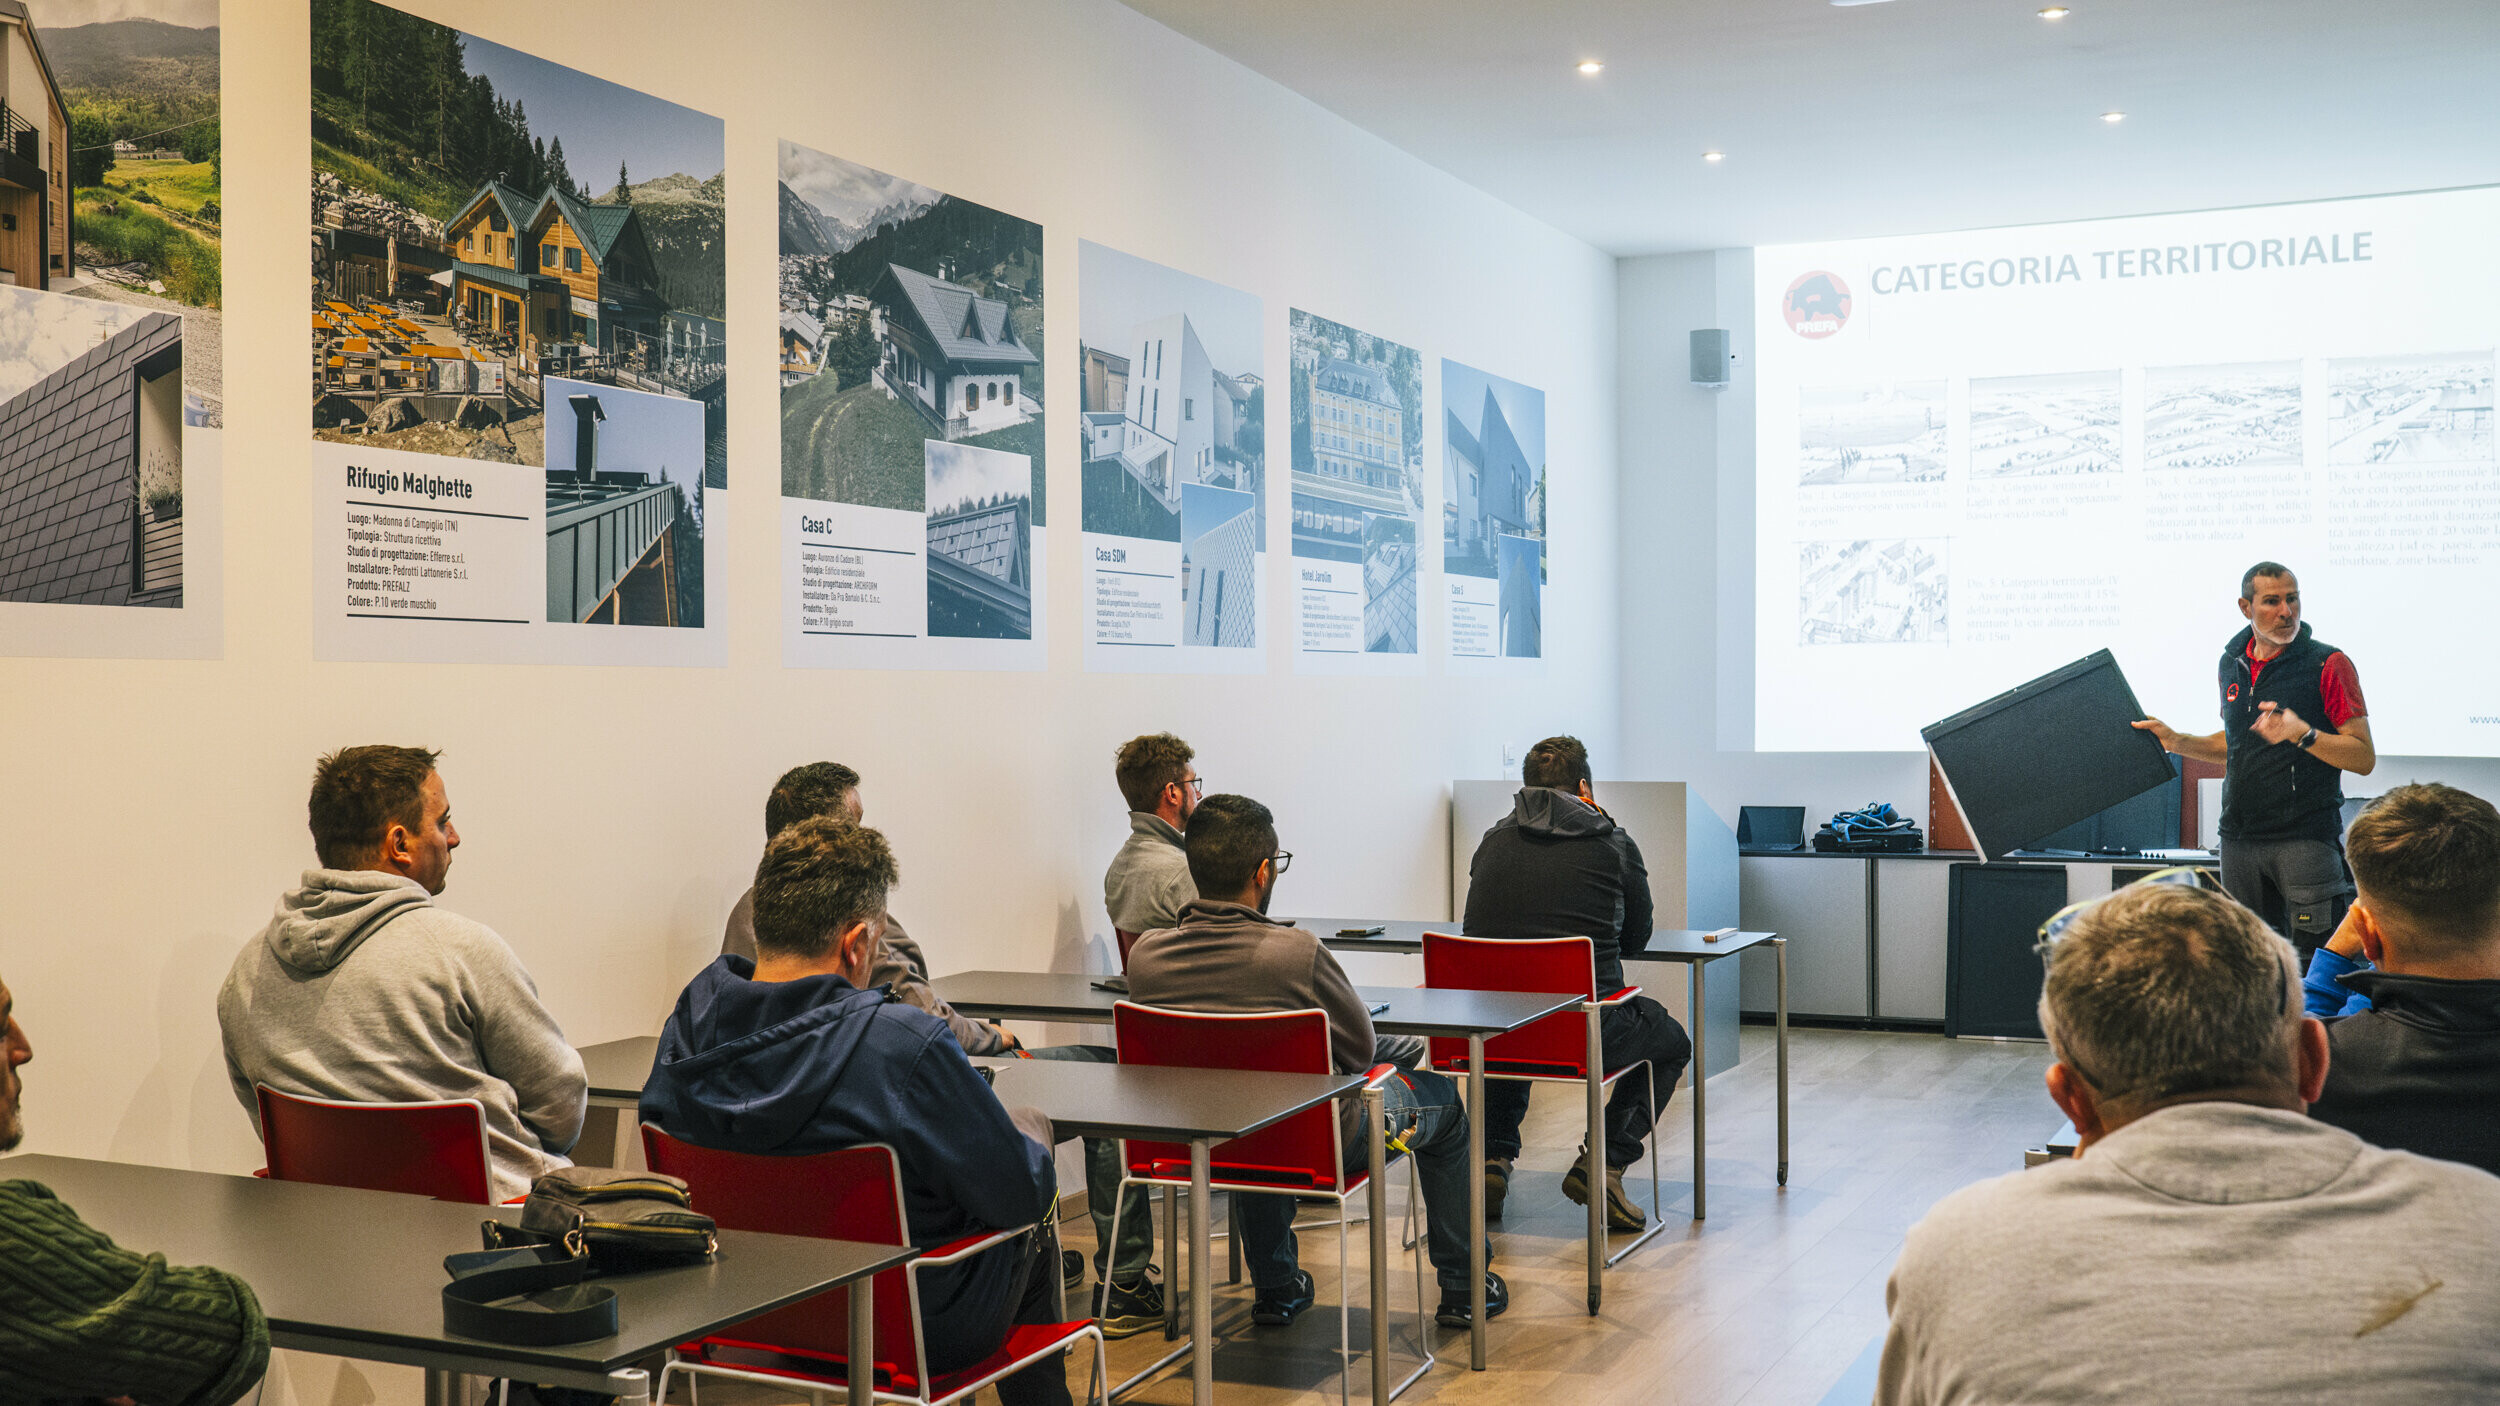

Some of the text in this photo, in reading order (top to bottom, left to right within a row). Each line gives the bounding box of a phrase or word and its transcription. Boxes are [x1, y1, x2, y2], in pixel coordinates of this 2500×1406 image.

[1871, 231, 2373, 295] CATEGORIA TERRITORIALE
[1796, 319, 1838, 334] PREFA
[2368, 470, 2422, 481] Categoria
[2426, 466, 2487, 478] territoriale
[347, 465, 473, 500] Rifugio Malghette
[2339, 485, 2365, 495] Aree
[2368, 485, 2389, 494] con
[2392, 484, 2460, 496] vegetazione
[2464, 481, 2479, 491] ed
[2363, 498, 2403, 509] altezza
[2406, 497, 2460, 508] uniforme
[347, 512, 371, 526] Luogo:
[373, 514, 403, 527] Madonna
[404, 517, 411, 527] di
[412, 517, 444, 532] Campiglio
[2395, 511, 2440, 522] ostacoli
[802, 515, 832, 535] Casa C
[2348, 527, 2370, 538] loro
[2374, 526, 2386, 537] di
[2426, 526, 2439, 536] di
[2442, 525, 2457, 536] 20
[2460, 524, 2490, 535] volte
[347, 528, 441, 546] Tipologia: Struttura ricettiva
[2354, 541, 2395, 552] altezza
[347, 545, 466, 564] Studio di progettazione: Efferre s.r.l.
[802, 551, 817, 563] Luogo:
[1096, 546, 1126, 563] Casa SDM
[2396, 556, 2424, 566] zone
[347, 562, 469, 580] Installatore: Pedrotti Lattonerie S.r.l.
[803, 564, 824, 576] Tipologia:
[347, 578, 410, 592] Prodotto: PREFALZ
[803, 577, 816, 587] Studio
[347, 595, 437, 610] Colore: P.10 verde muschio
[803, 603, 823, 613] Prodotto:
[803, 616, 819, 626] Colore:
